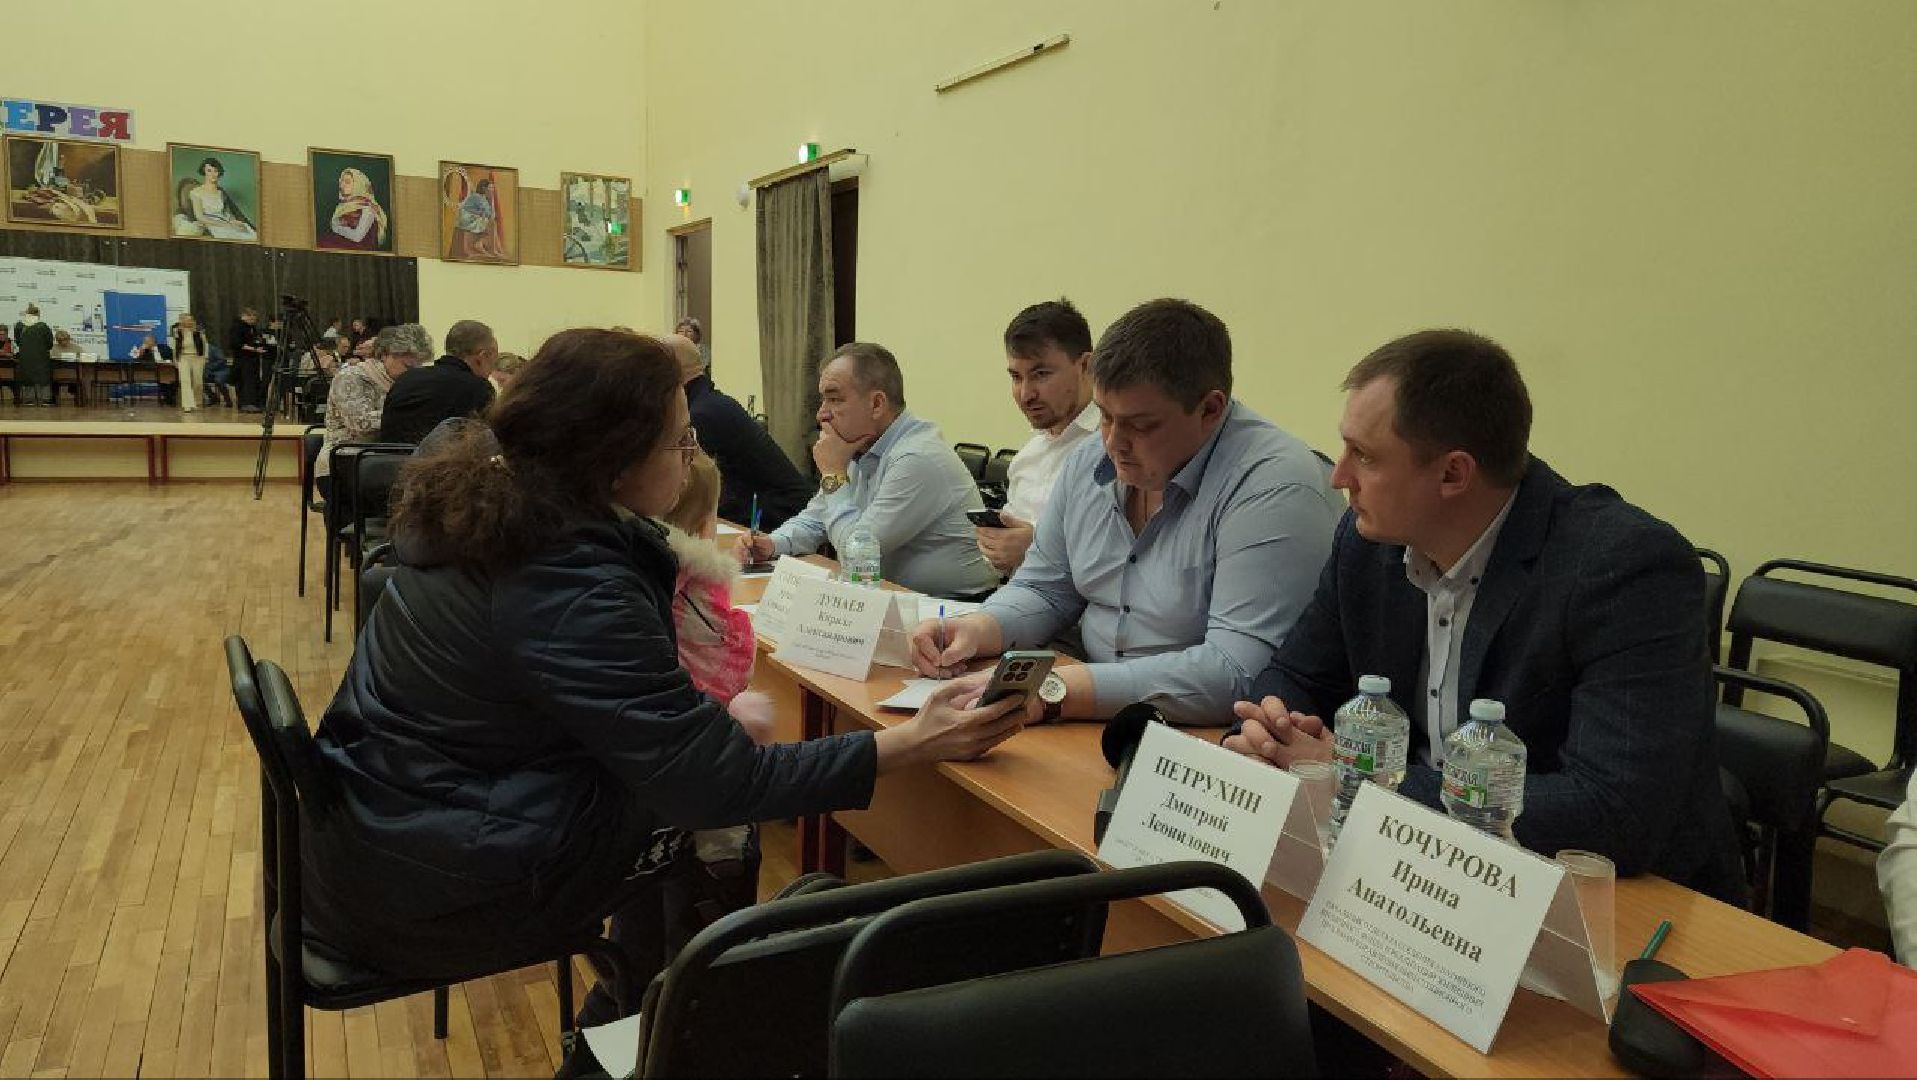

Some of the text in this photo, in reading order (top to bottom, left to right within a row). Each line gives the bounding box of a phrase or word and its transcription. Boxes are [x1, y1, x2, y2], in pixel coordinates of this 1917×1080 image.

[0, 101, 131, 140] ЕРЕЯ
[815, 594, 865, 613] ДУНАЕВ
[1153, 756, 1263, 814] ПЕТРУХИН
[1160, 791, 1230, 832] Дмитрий
[1141, 812, 1231, 865] Леонидович
[1378, 815, 1520, 899] КОЧУРОВА
[1391, 858, 1461, 910] Ирина
[1348, 877, 1483, 964] Анатольевна
